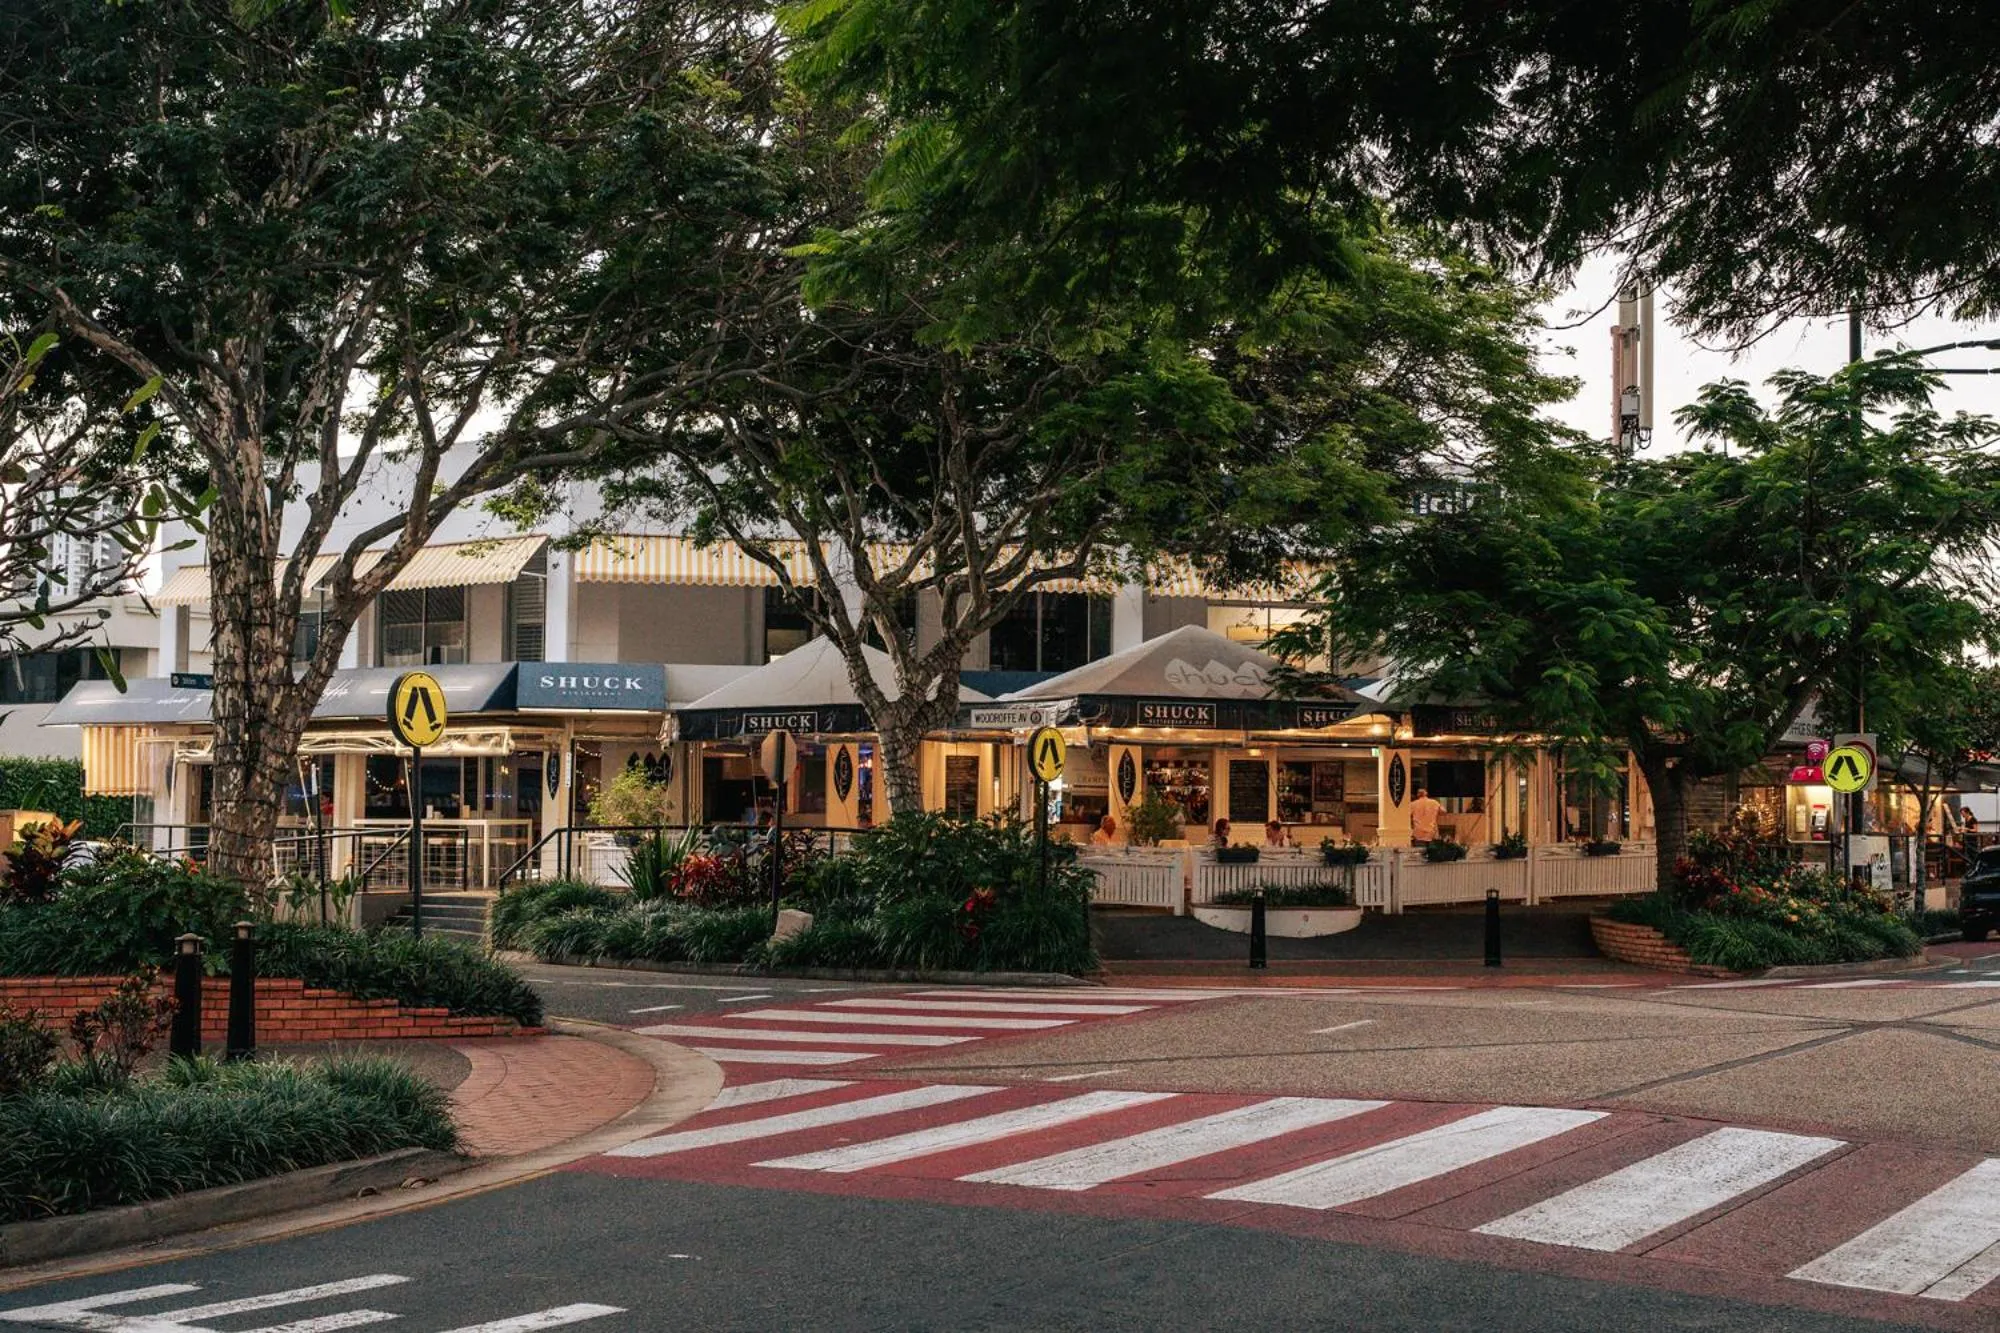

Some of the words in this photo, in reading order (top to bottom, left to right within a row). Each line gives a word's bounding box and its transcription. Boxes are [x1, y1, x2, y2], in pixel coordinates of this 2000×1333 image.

[540, 675, 643, 690] SHUCK
[975, 712, 1017, 724] WOODROFFE
[1144, 705, 1210, 720] SHUCK
[749, 715, 811, 729] SHUCK
